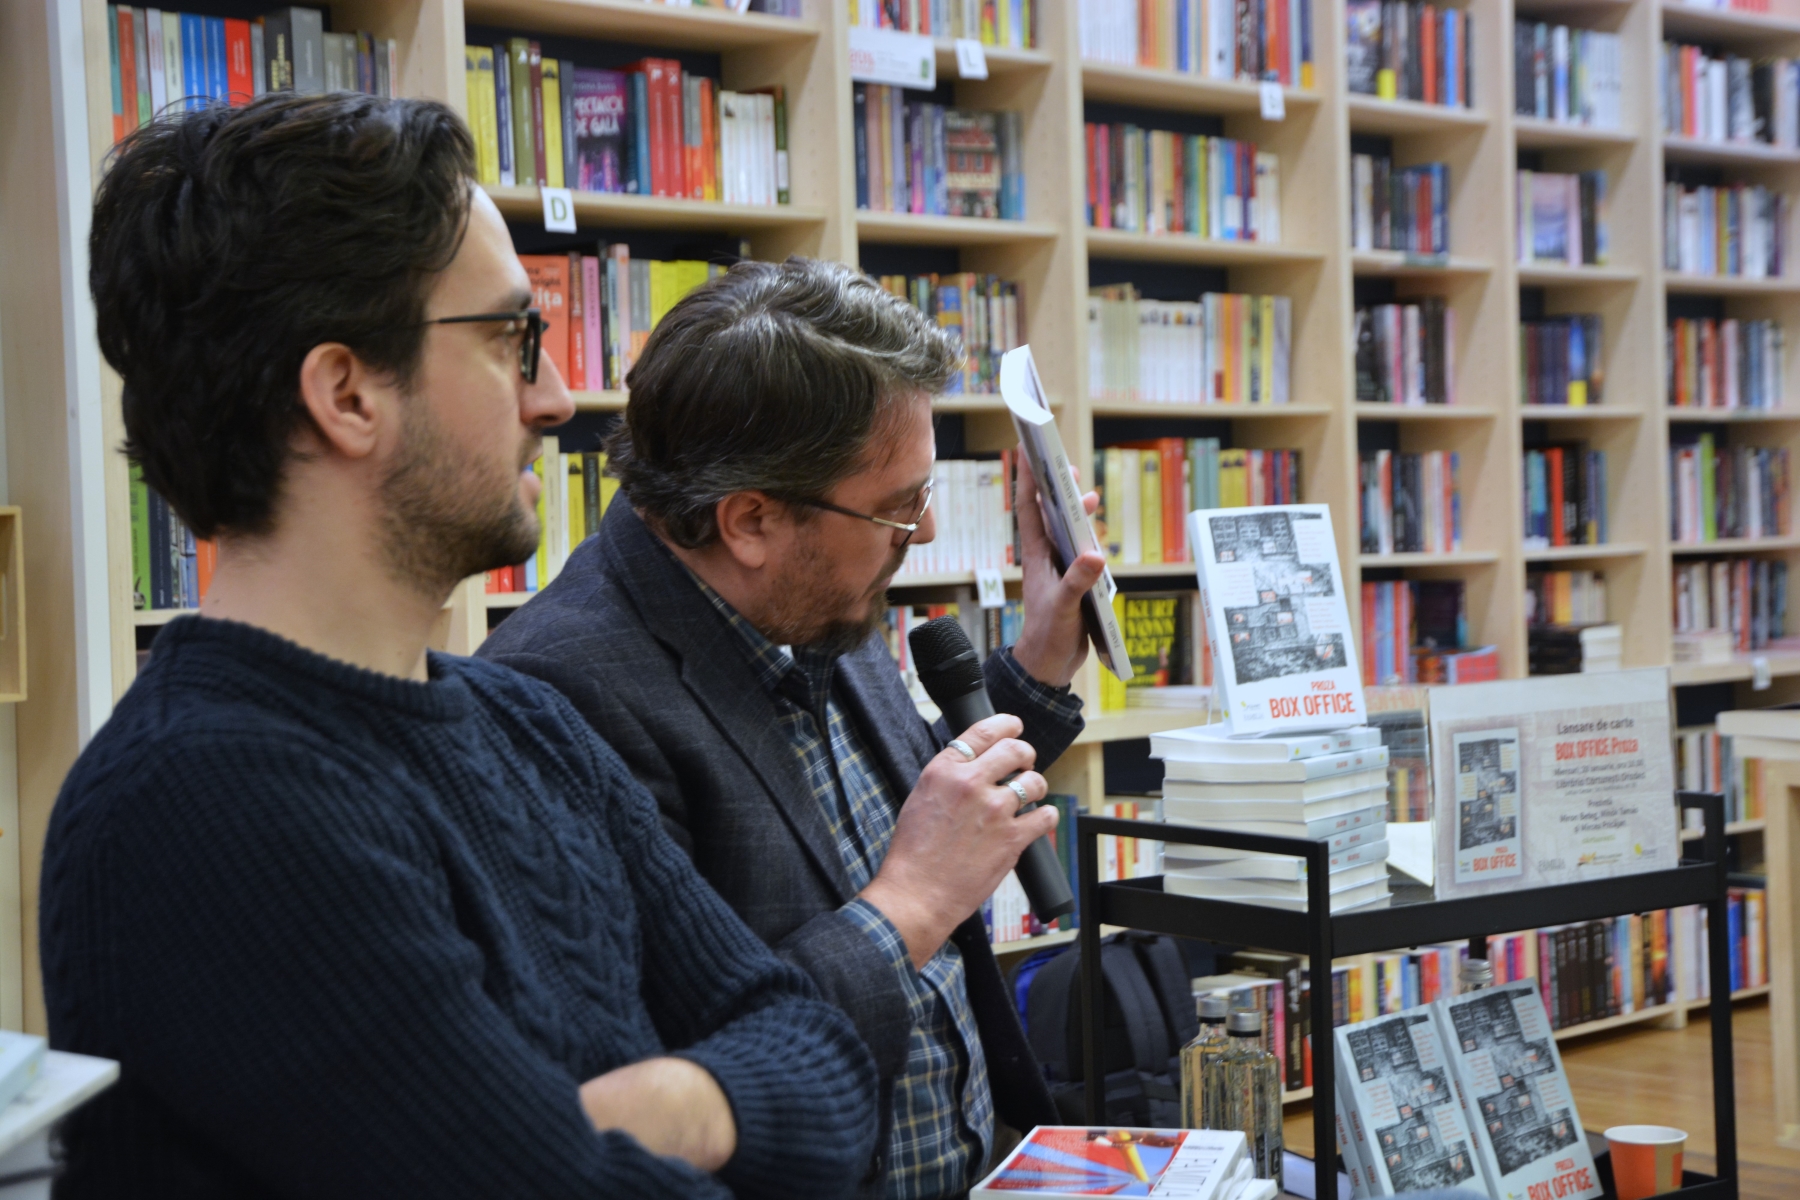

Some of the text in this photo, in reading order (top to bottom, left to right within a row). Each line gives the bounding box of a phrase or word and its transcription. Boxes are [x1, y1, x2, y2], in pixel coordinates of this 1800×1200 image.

[574, 95, 624, 116] PECTACOL
[551, 197, 567, 221] D
[983, 580, 1000, 598] M
[1126, 599, 1178, 617] KURT
[1107, 620, 1121, 649] FAMILIA
[1126, 619, 1176, 636] VONN
[1126, 637, 1175, 656] EGUT
[1311, 680, 1336, 691] PROZA
[1269, 696, 1301, 719] BOX
[1303, 693, 1356, 717] OFFICE
[1557, 718, 1634, 735] Lansare de carte
[1555, 737, 1638, 760] BOX OFFICE Proza
[1472, 857, 1490, 872] BOX
[1491, 853, 1517, 869] OFFICE
[1527, 1167, 1594, 1200] BOX OFFICE
